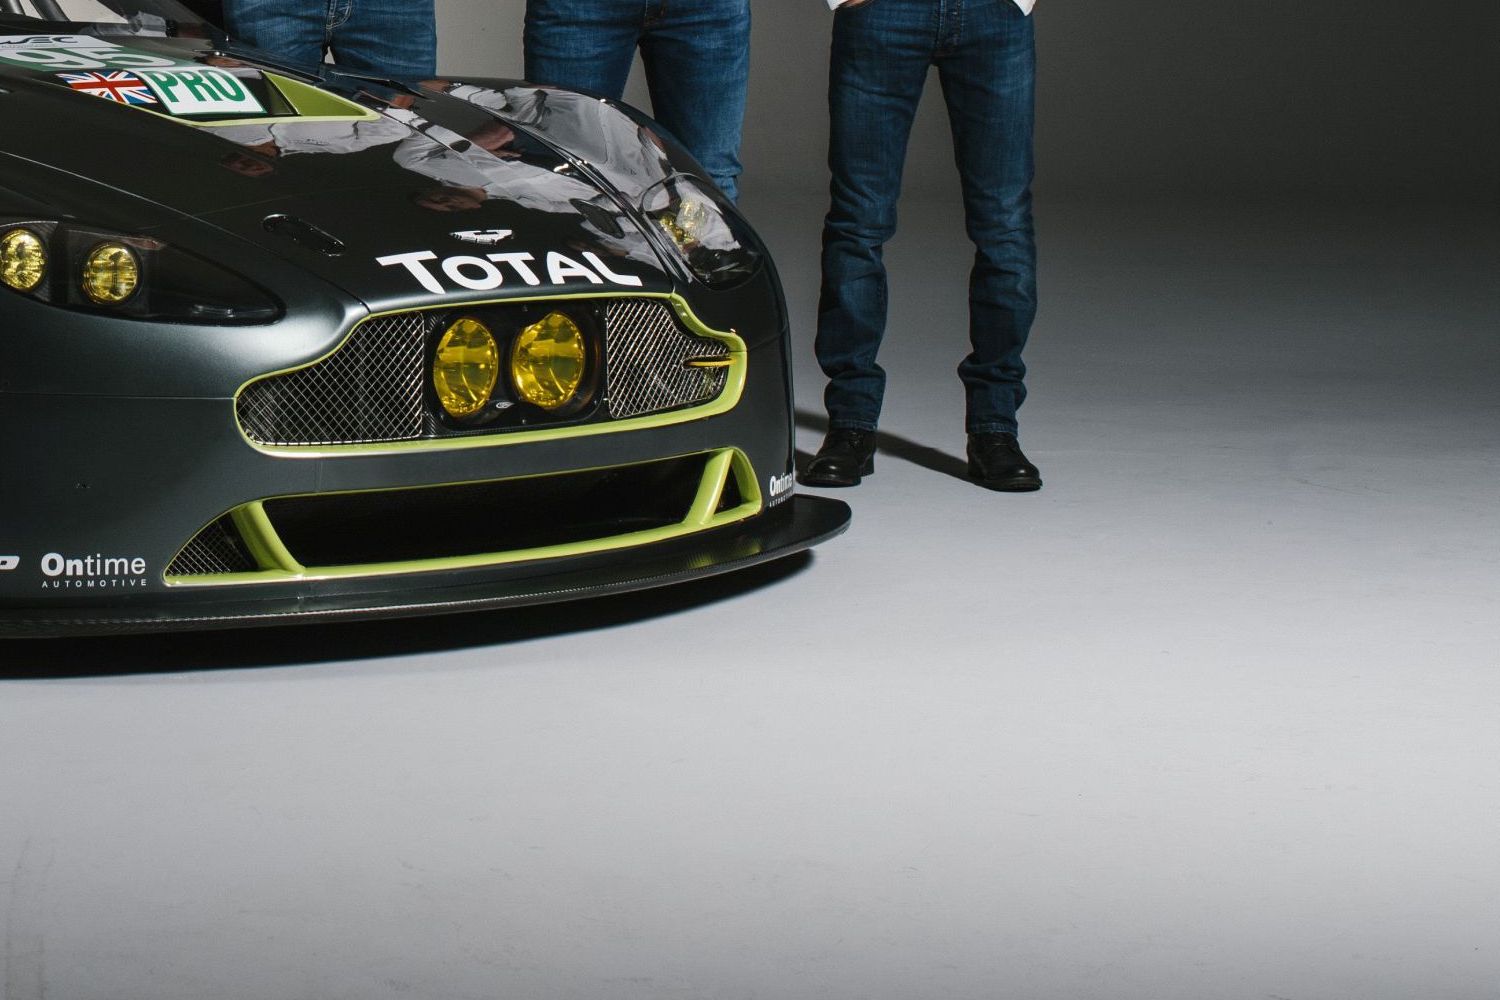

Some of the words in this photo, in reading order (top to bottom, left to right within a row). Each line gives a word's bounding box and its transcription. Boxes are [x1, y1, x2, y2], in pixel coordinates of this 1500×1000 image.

[146, 69, 247, 103] PRO
[41, 552, 146, 577] Ontime
[41, 579, 147, 589] AUTOMOTIVE
